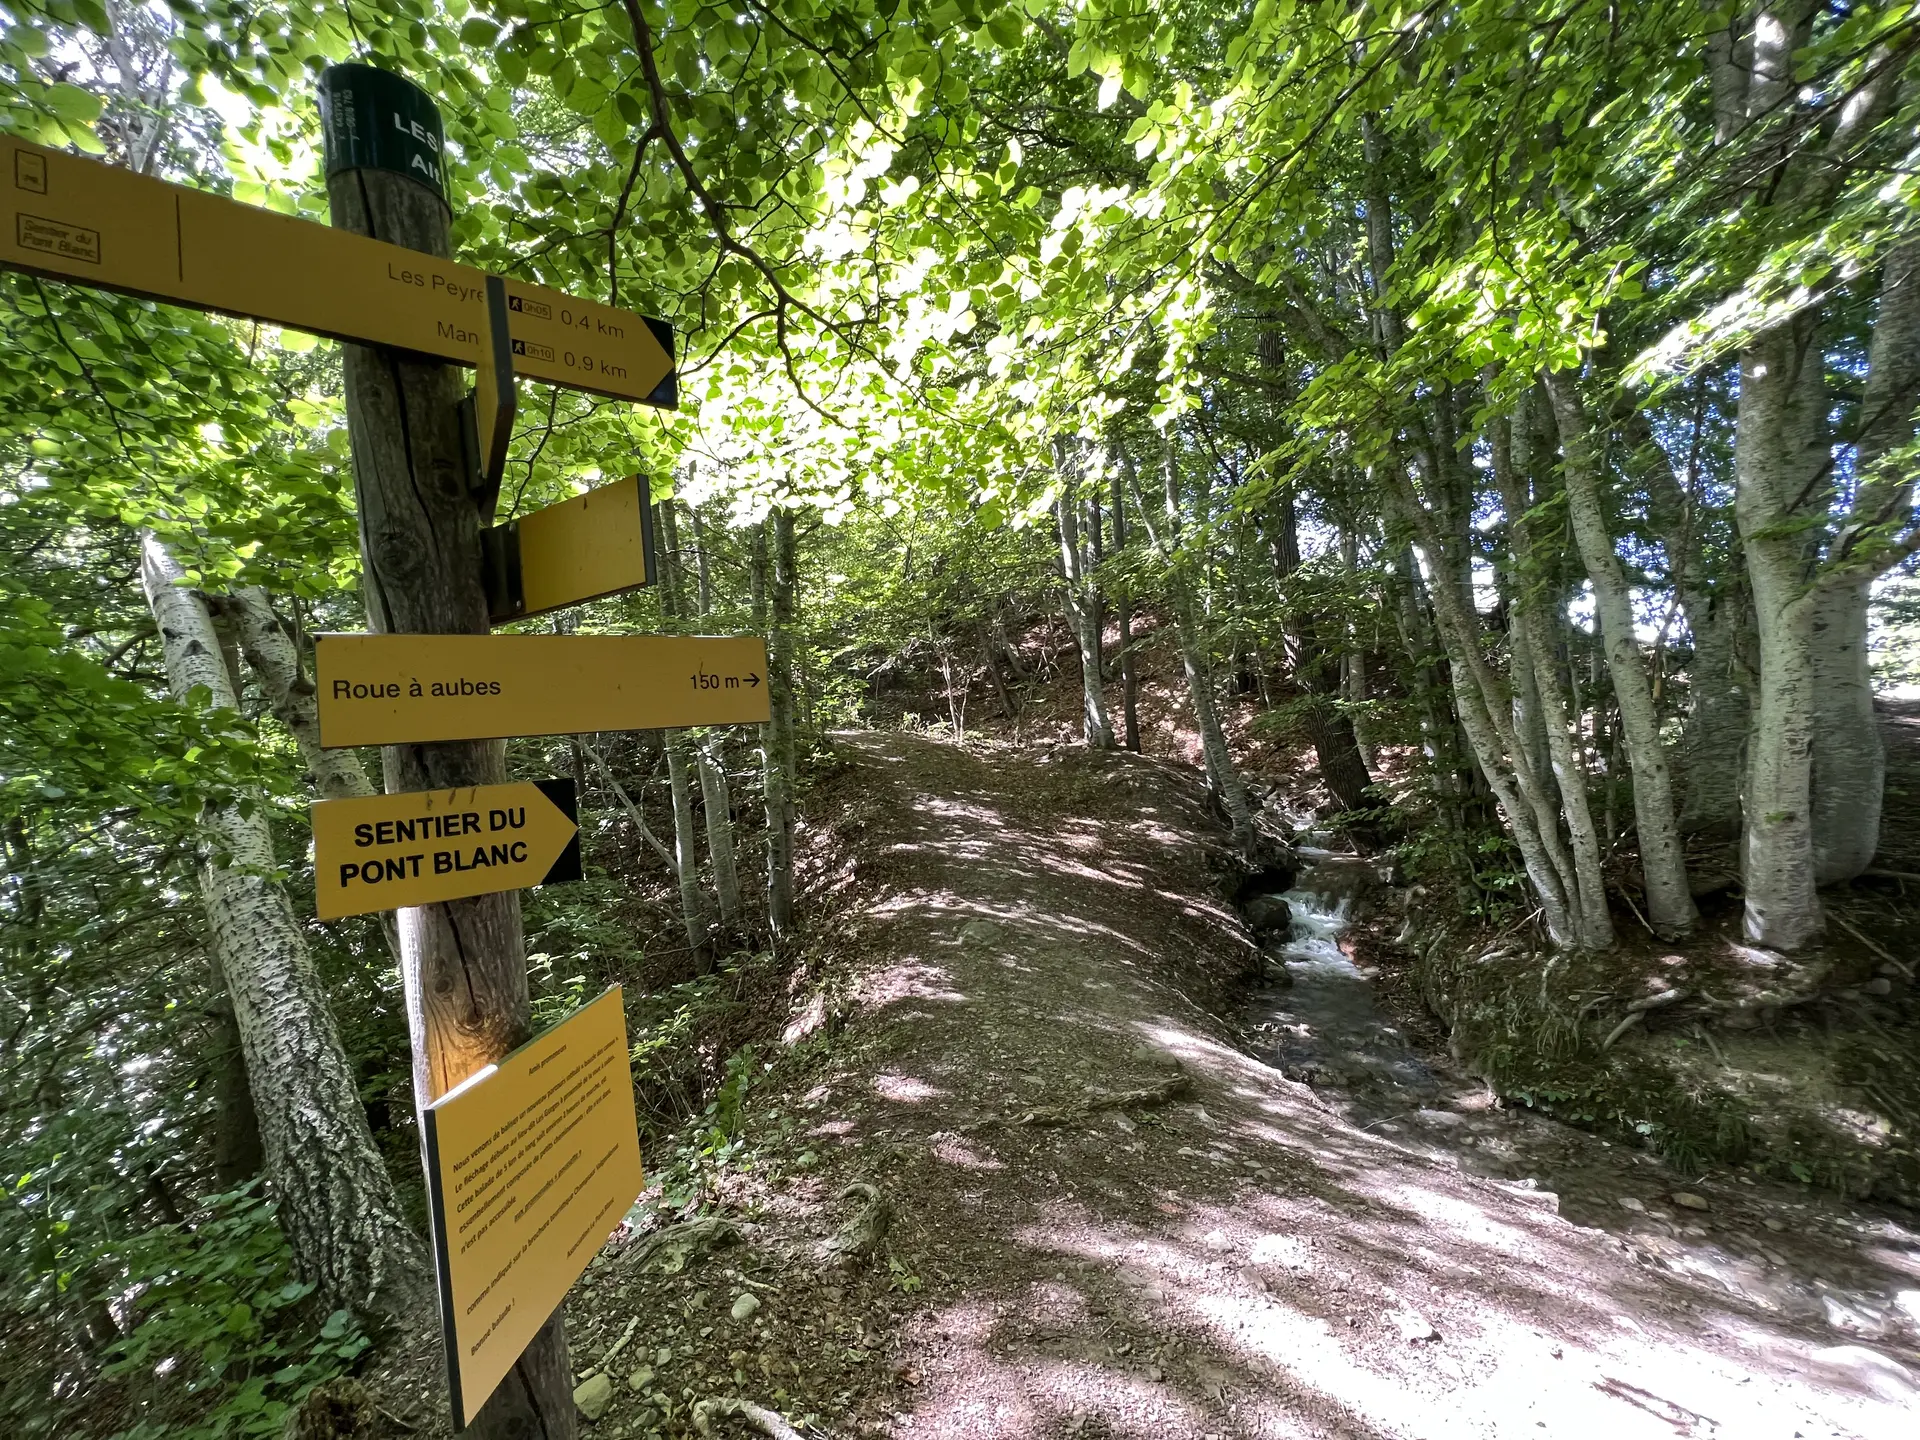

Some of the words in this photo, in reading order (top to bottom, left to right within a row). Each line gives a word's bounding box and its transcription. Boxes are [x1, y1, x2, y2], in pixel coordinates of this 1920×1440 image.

[394, 112, 438, 152] LES
[23, 232, 53, 249] Pont
[58, 240, 97, 259] Blanc
[76, 232, 92, 246] du
[388, 262, 425, 287] Les
[523, 302, 549, 317] 0h05
[561, 309, 590, 330] 0,4
[597, 318, 625, 339] km
[526, 345, 552, 359] 0h10
[564, 351, 594, 372] 0,9
[600, 360, 628, 380] km
[332, 680, 401, 699] Roue
[409, 678, 423, 698] à
[431, 678, 501, 697] aubes
[690, 674, 720, 690] 150
[723, 677, 740, 689] m
[354, 812, 480, 848] SENTIER
[490, 807, 527, 831] DU
[339, 854, 425, 888] PONT
[434, 841, 528, 876] BLANC
[453, 1155, 470, 1173] Nous
[470, 1137, 492, 1159] venons
[493, 1131, 500, 1141] de
[500, 1116, 519, 1135] baliser
[519, 1110, 526, 1120] un
[526, 1094, 547, 1114] nouveau
[464, 1161, 489, 1186] fléchage
[490, 1143, 510, 1164] débute
[510, 1137, 517, 1147] au
[517, 1120, 536, 1140] lieu-dit
[535, 1113, 544, 1124] Les
[583, 1076, 588, 1084] de
[457, 1194, 474, 1213] Cette
[474, 1176, 495, 1198] balade
[495, 1169, 503, 1179] de
[503, 1163, 508, 1172] 5
[508, 1156, 517, 1168] km
[517, 1150, 524, 1159] de
[525, 1139, 536, 1152] long
[580, 1095, 586, 1103] de
[459, 1185, 506, 1234] essentiellement
[532, 1155, 539, 1164] de
[461, 1234, 477, 1254] n'est
[477, 1224, 488, 1240] pas
[489, 1196, 516, 1227] accessible
[467, 1286, 490, 1315] comme
[491, 1259, 512, 1288] indiqué
[513, 1250, 521, 1264] sur
[471, 1328, 491, 1356] Bonne
[491, 1304, 511, 1331] balade
